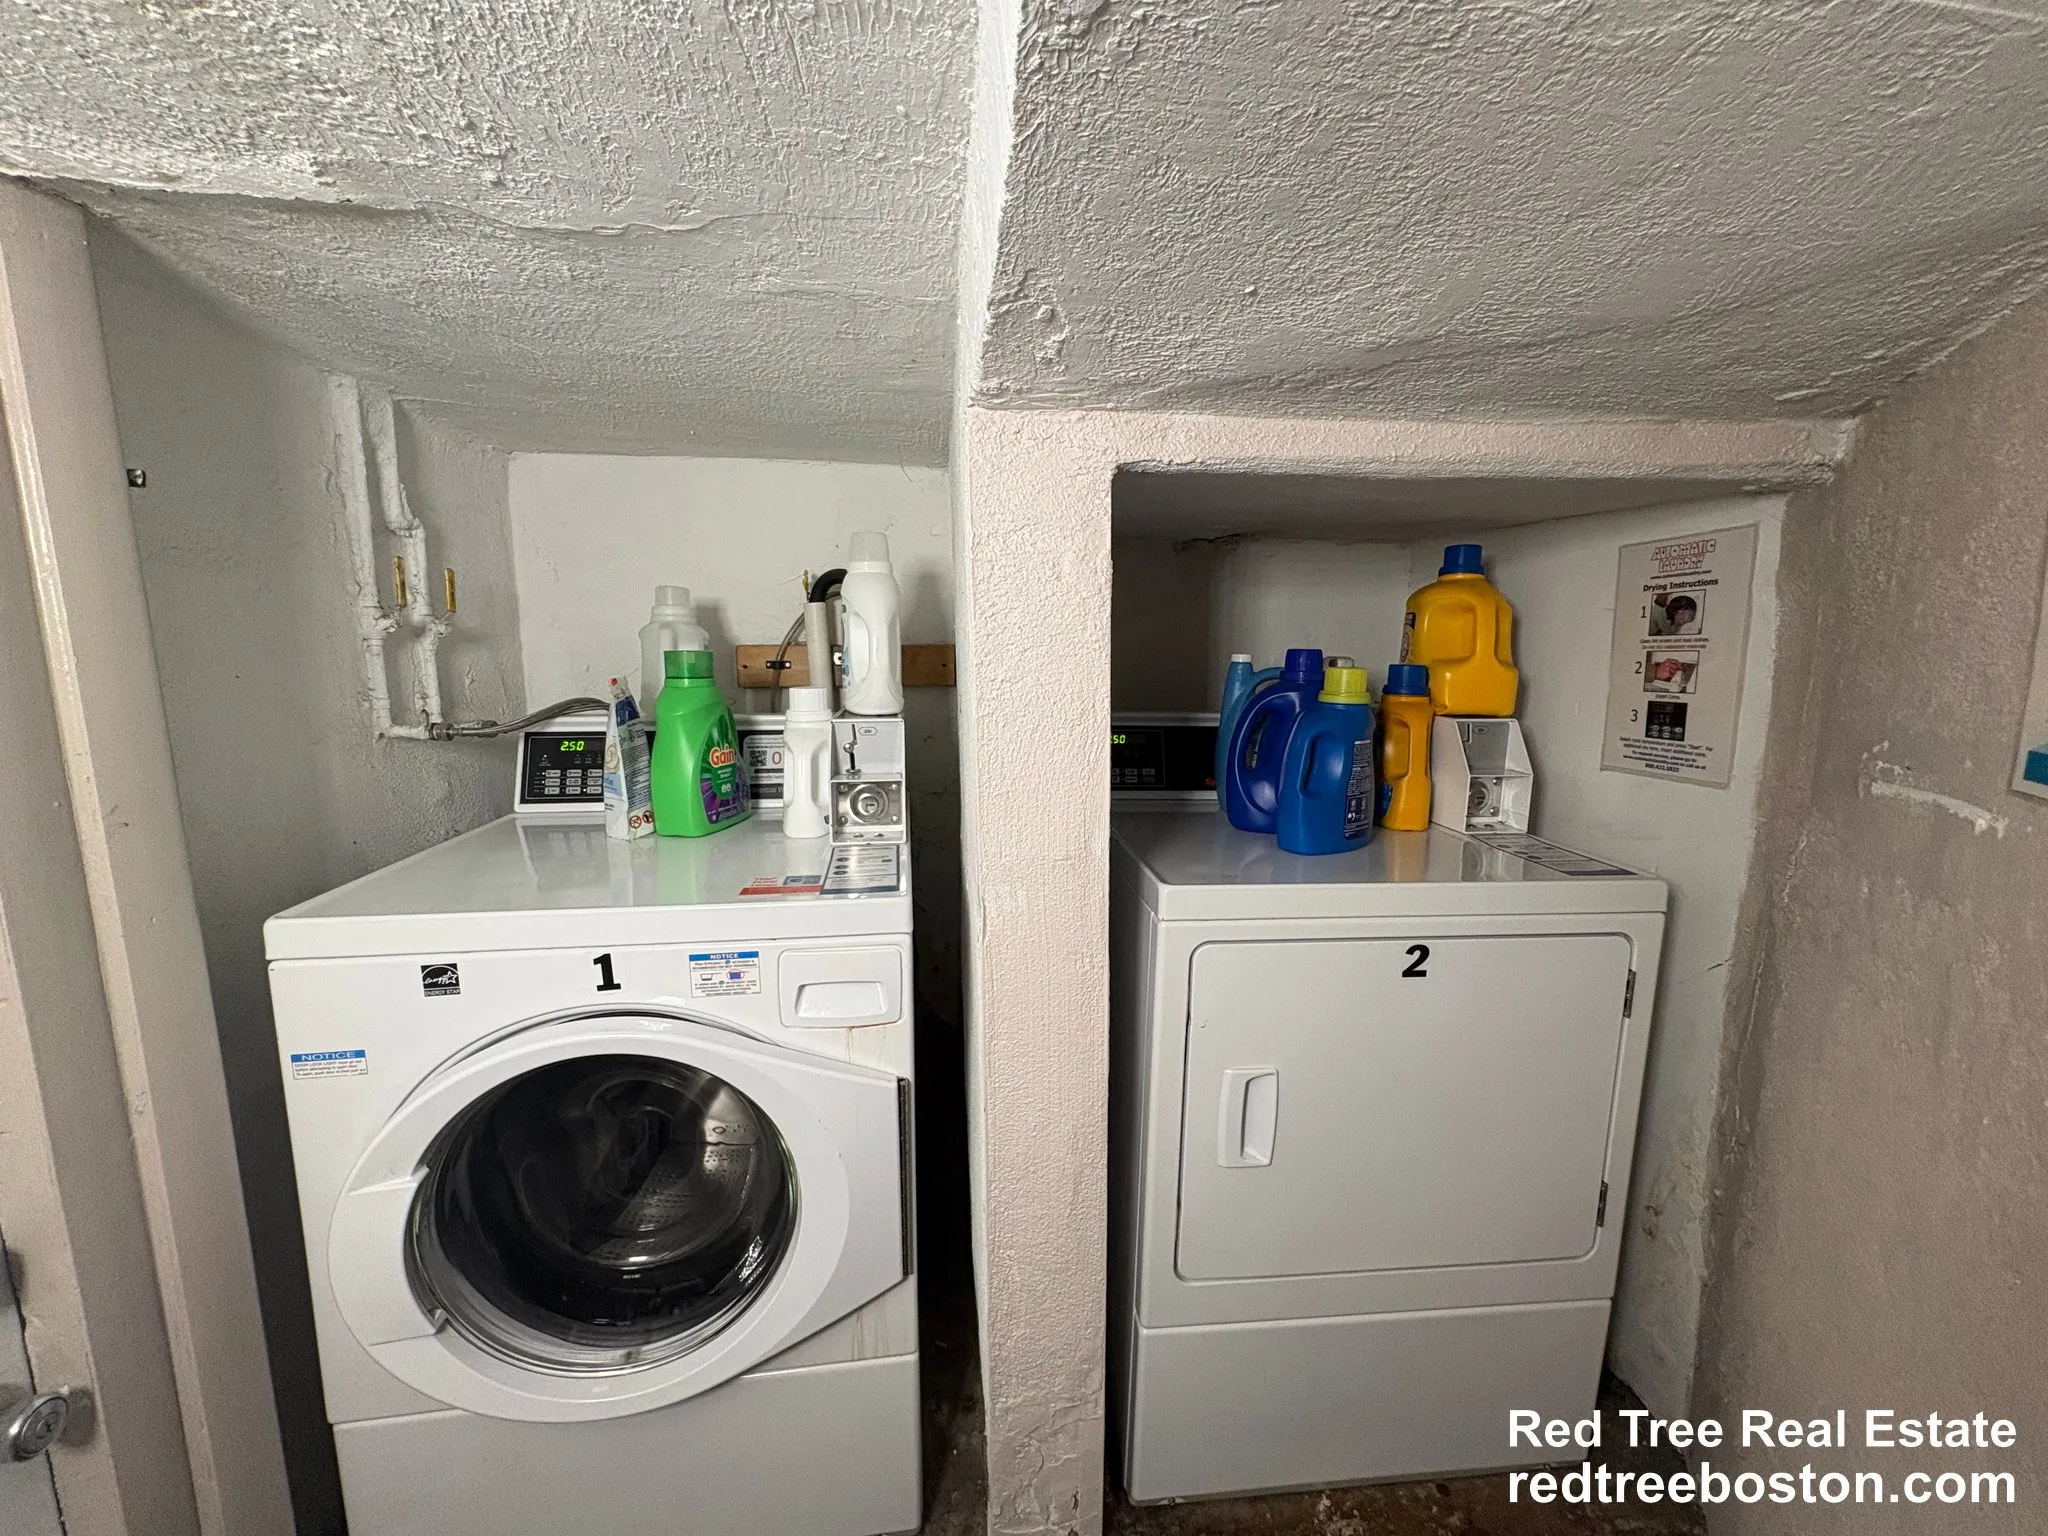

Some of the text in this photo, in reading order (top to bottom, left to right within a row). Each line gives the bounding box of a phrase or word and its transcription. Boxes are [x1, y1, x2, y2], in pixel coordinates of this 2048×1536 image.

[1651, 539, 1716, 561] AUTOMATIC
[1659, 555, 1705, 573] LAUNDRY
[1643, 578, 1719, 593] Drying Instructions
[1640, 605, 1647, 618] 1
[1634, 661, 1642, 674] 2
[1630, 709, 1638, 722] 3
[560, 741, 585, 751] 2.50
[1110, 735, 1126, 744] 50
[709, 744, 736, 767] Gain
[1402, 944, 1430, 977] 2
[593, 953, 621, 991] 1
[301, 1051, 356, 1061] NOTICE
